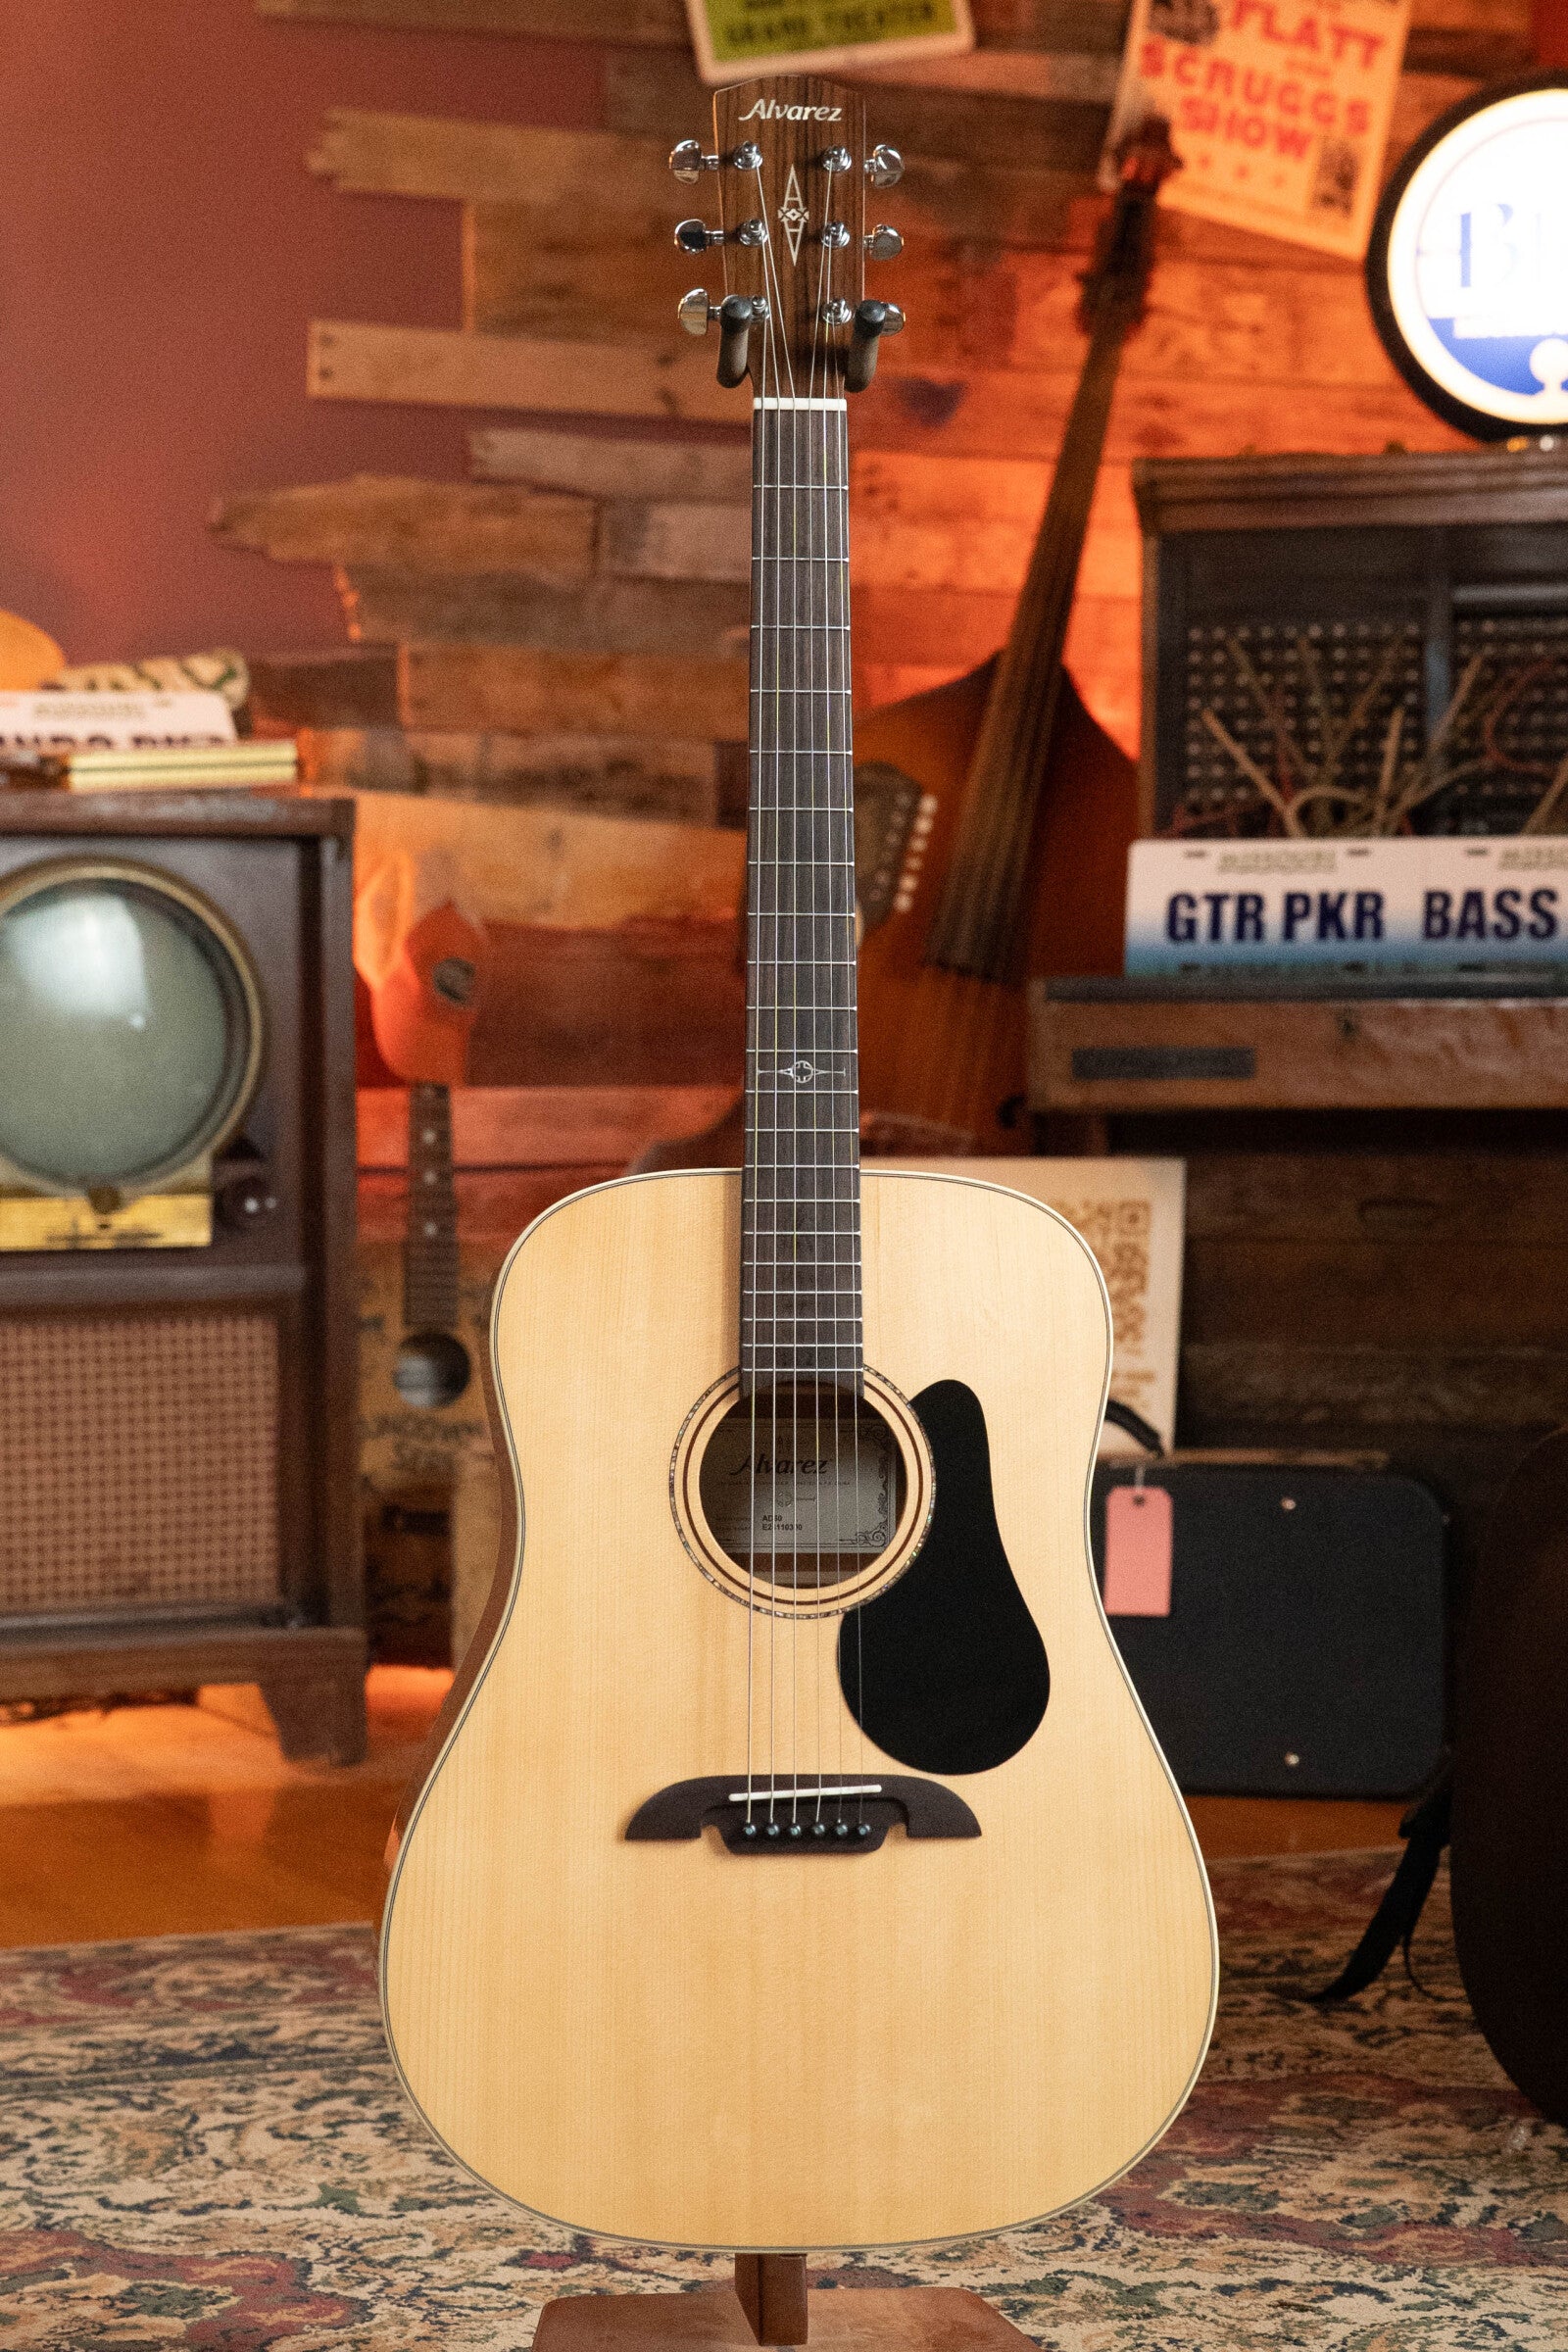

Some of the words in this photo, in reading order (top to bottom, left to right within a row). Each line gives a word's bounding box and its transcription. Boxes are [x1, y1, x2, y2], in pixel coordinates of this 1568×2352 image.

[738, 98, 843, 122] Alvarez
[1166, 892, 1265, 943] GTR
[1283, 890, 1385, 942] PKR
[1422, 888, 1559, 941] BASS
[729, 1452, 829, 1477] Alvarez
